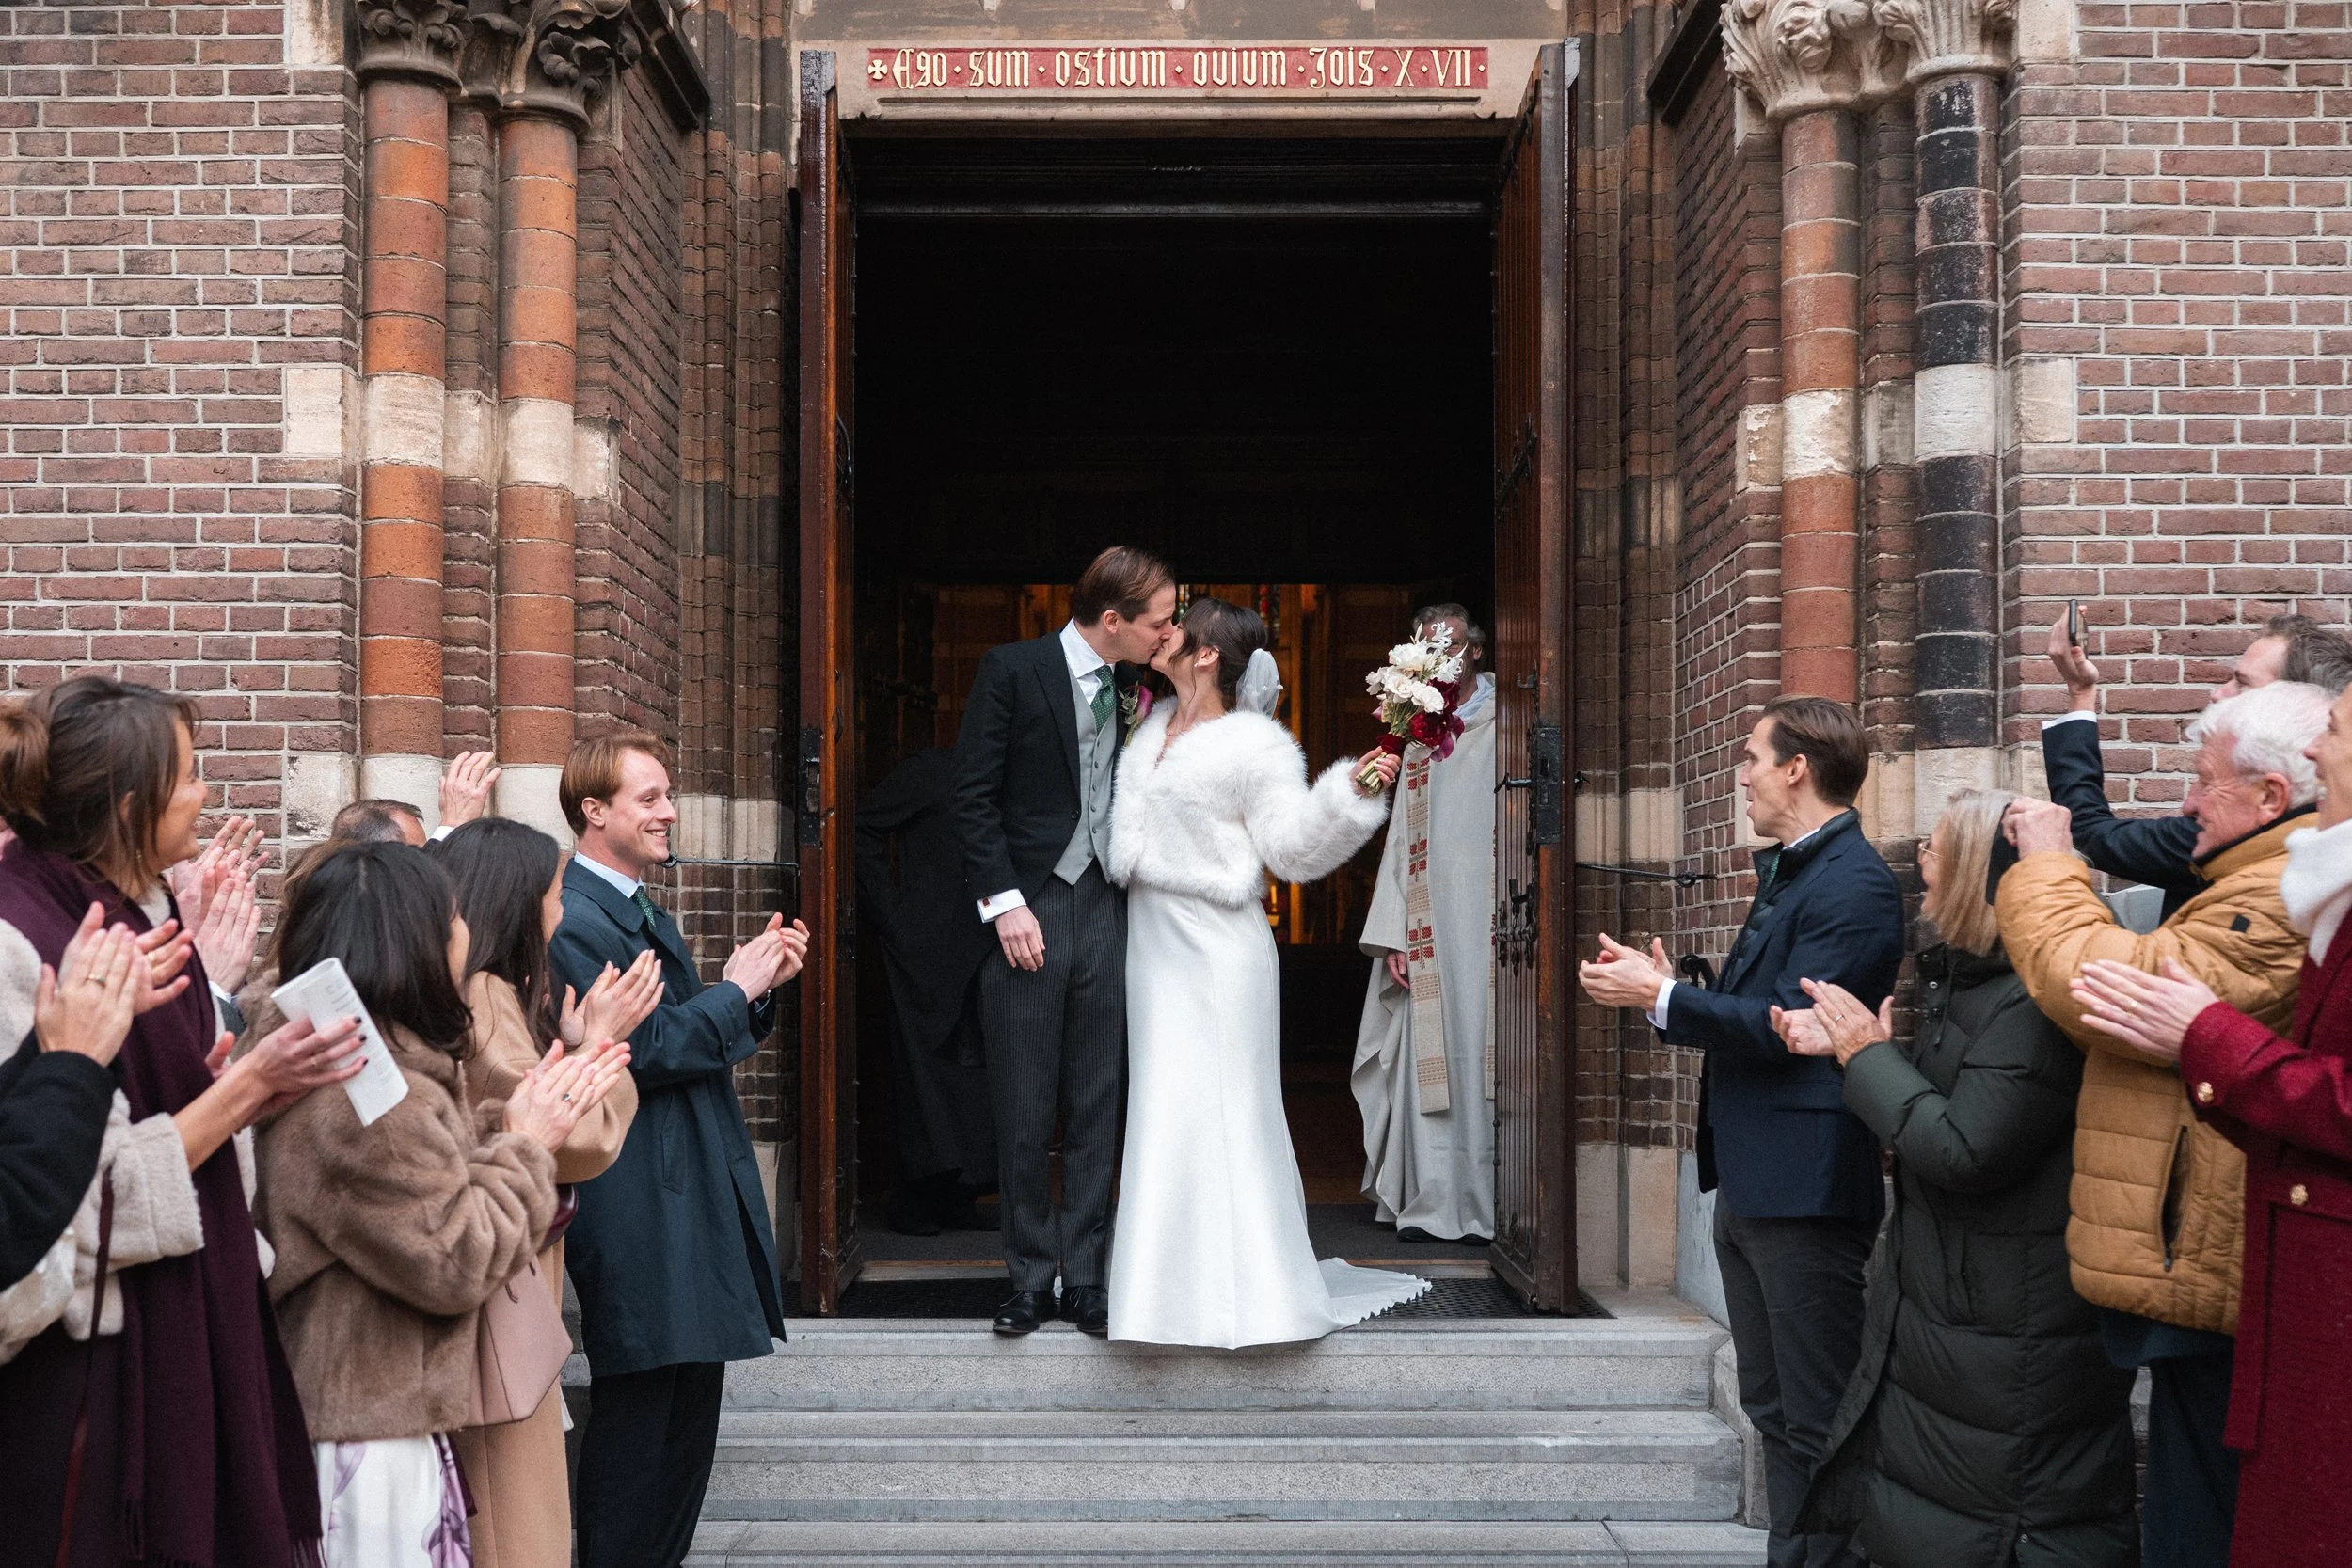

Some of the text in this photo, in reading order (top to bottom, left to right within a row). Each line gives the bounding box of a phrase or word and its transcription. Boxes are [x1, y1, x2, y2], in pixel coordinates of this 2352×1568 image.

[893, 48, 947, 89] Ego
[969, 50, 1029, 87] sum
[1056, 47, 1166, 87] ostium
[1309, 47, 1374, 89] Jois
[1393, 50, 1415, 87] X
[1430, 50, 1471, 87] VII
